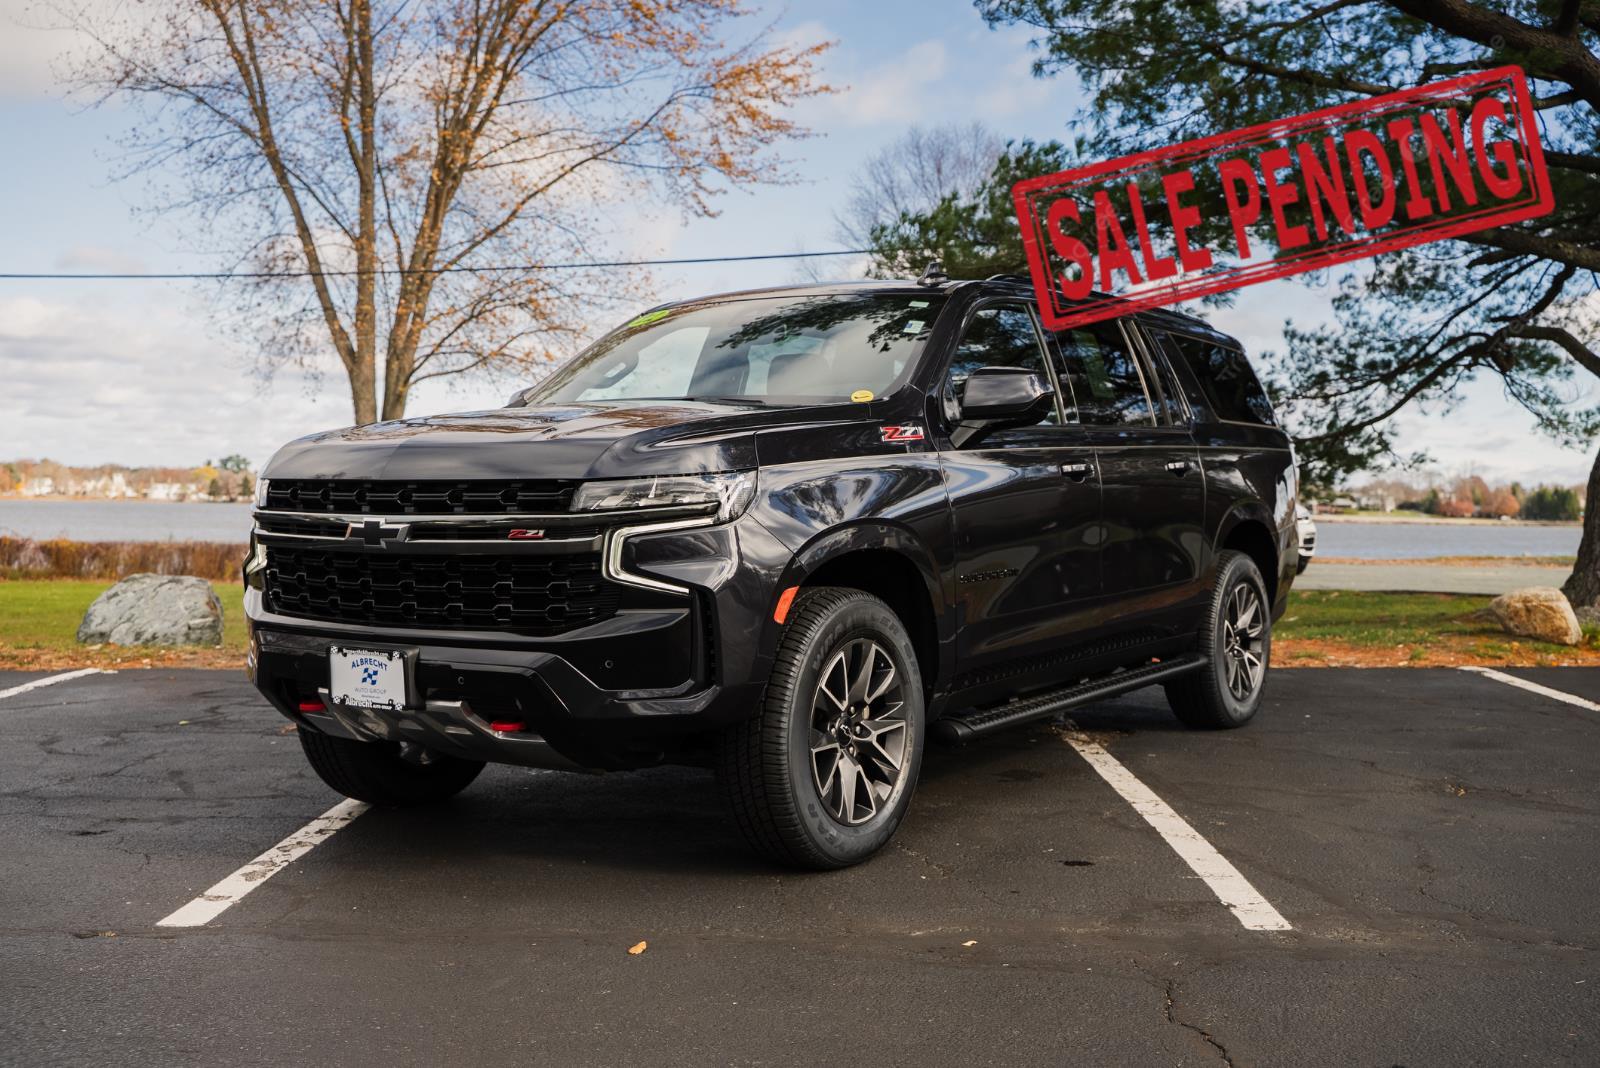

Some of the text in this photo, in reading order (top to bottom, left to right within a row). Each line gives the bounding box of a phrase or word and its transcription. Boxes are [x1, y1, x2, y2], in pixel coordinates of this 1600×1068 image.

[880, 426, 925, 442] Z71
[351, 657, 388, 671] ALBRECHT
[345, 697, 373, 709] Albrecht
